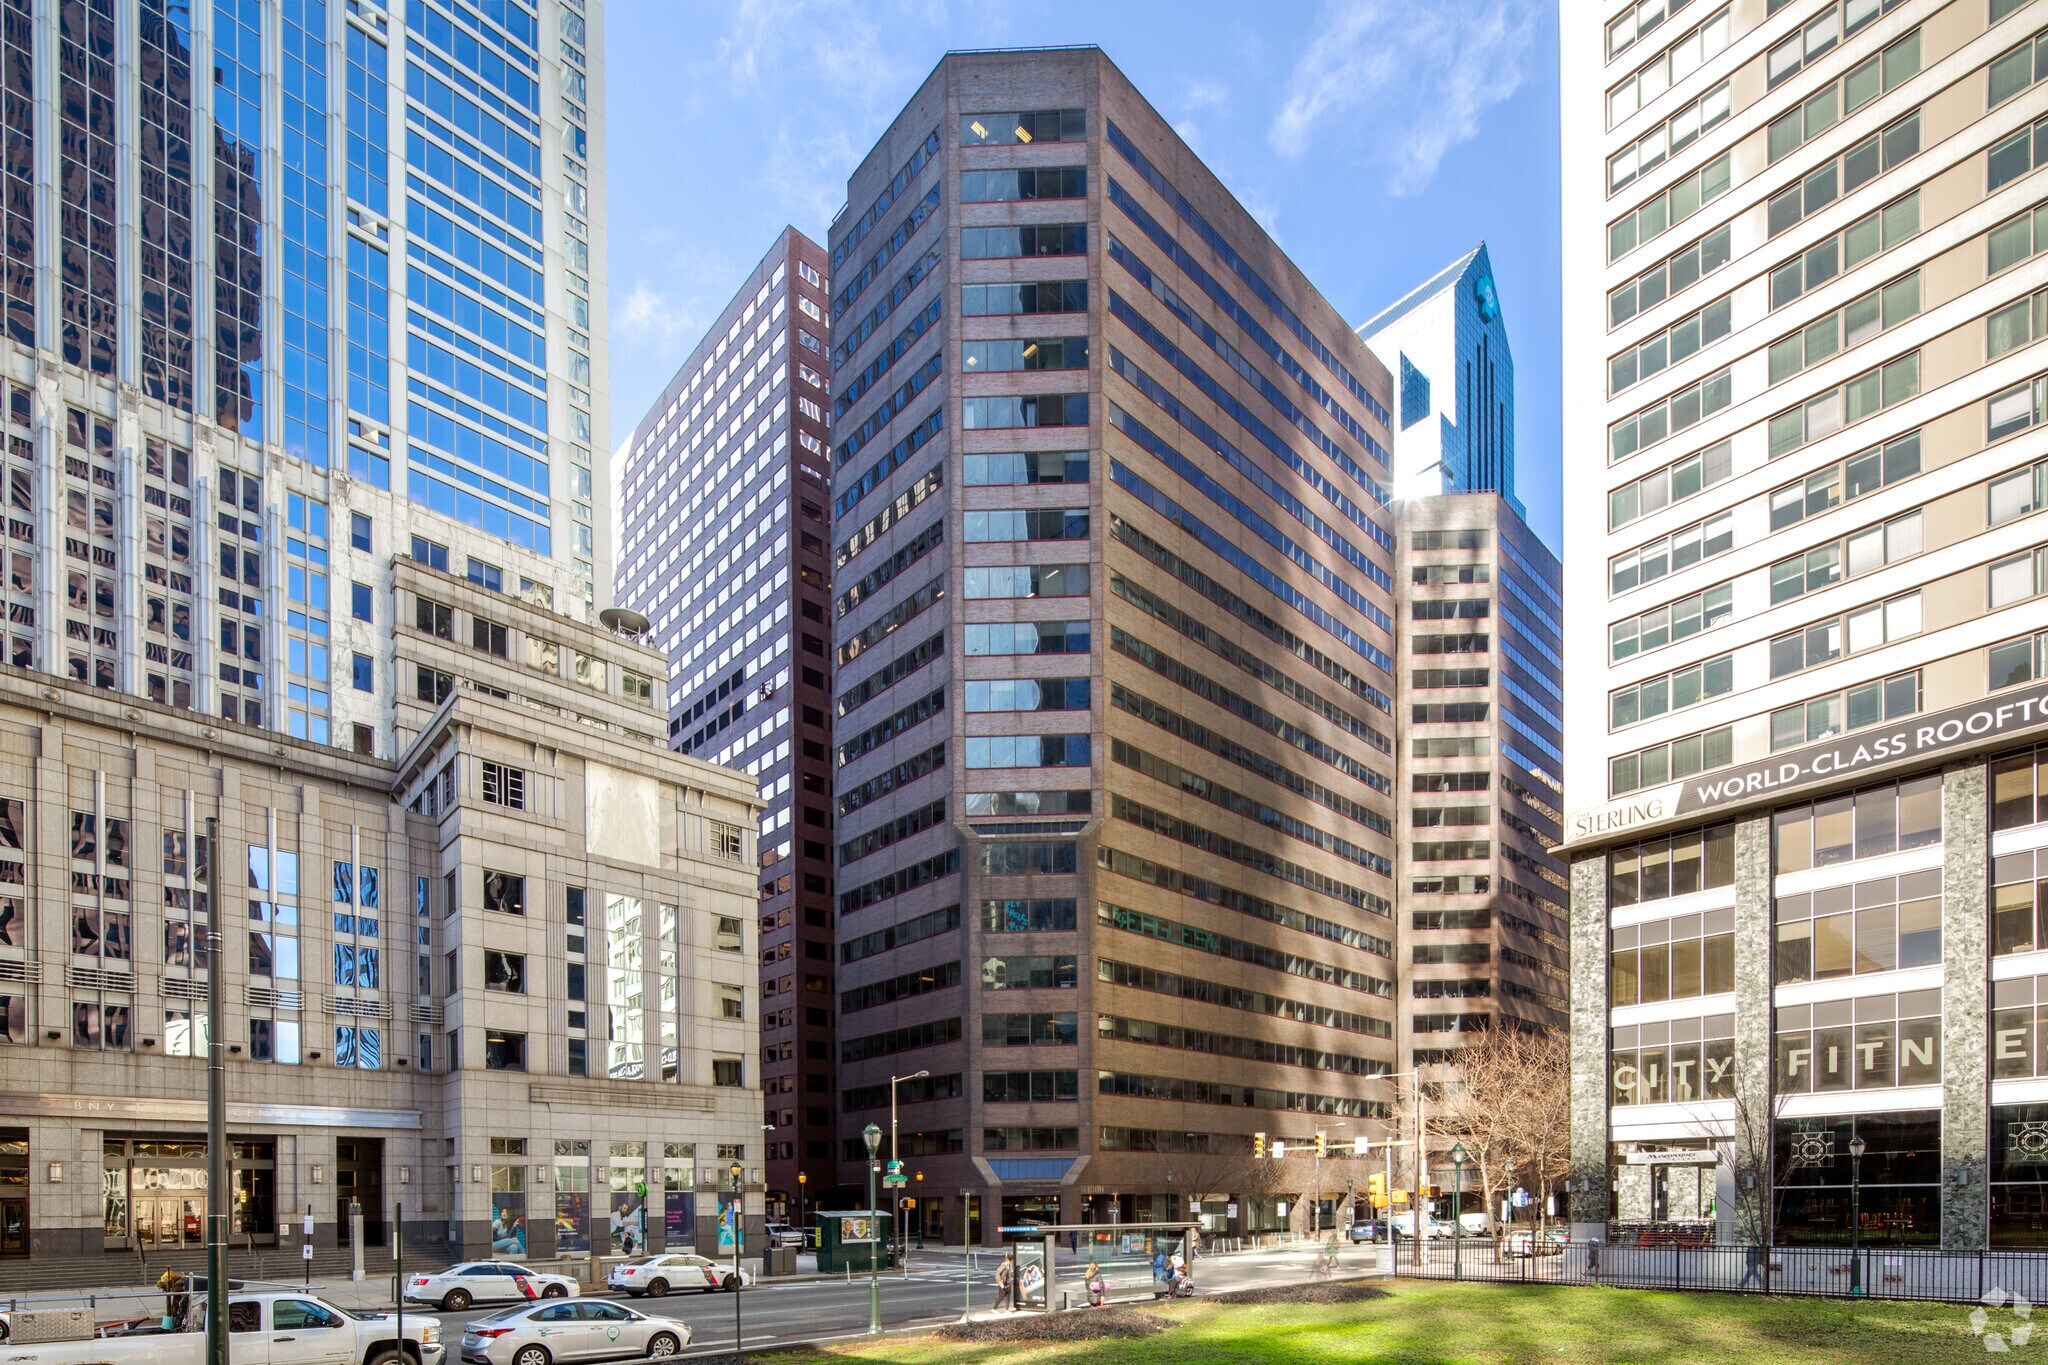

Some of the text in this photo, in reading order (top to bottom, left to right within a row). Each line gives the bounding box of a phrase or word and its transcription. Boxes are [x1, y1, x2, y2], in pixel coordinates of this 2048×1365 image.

[1697, 732, 1907, 805] WORLD-CLASS
[1575, 799, 1663, 837] STERLING
[1613, 1028, 2048, 1091] CITY FITNE
[74, 1101, 303, 1121] BNY MELLO CENTER
